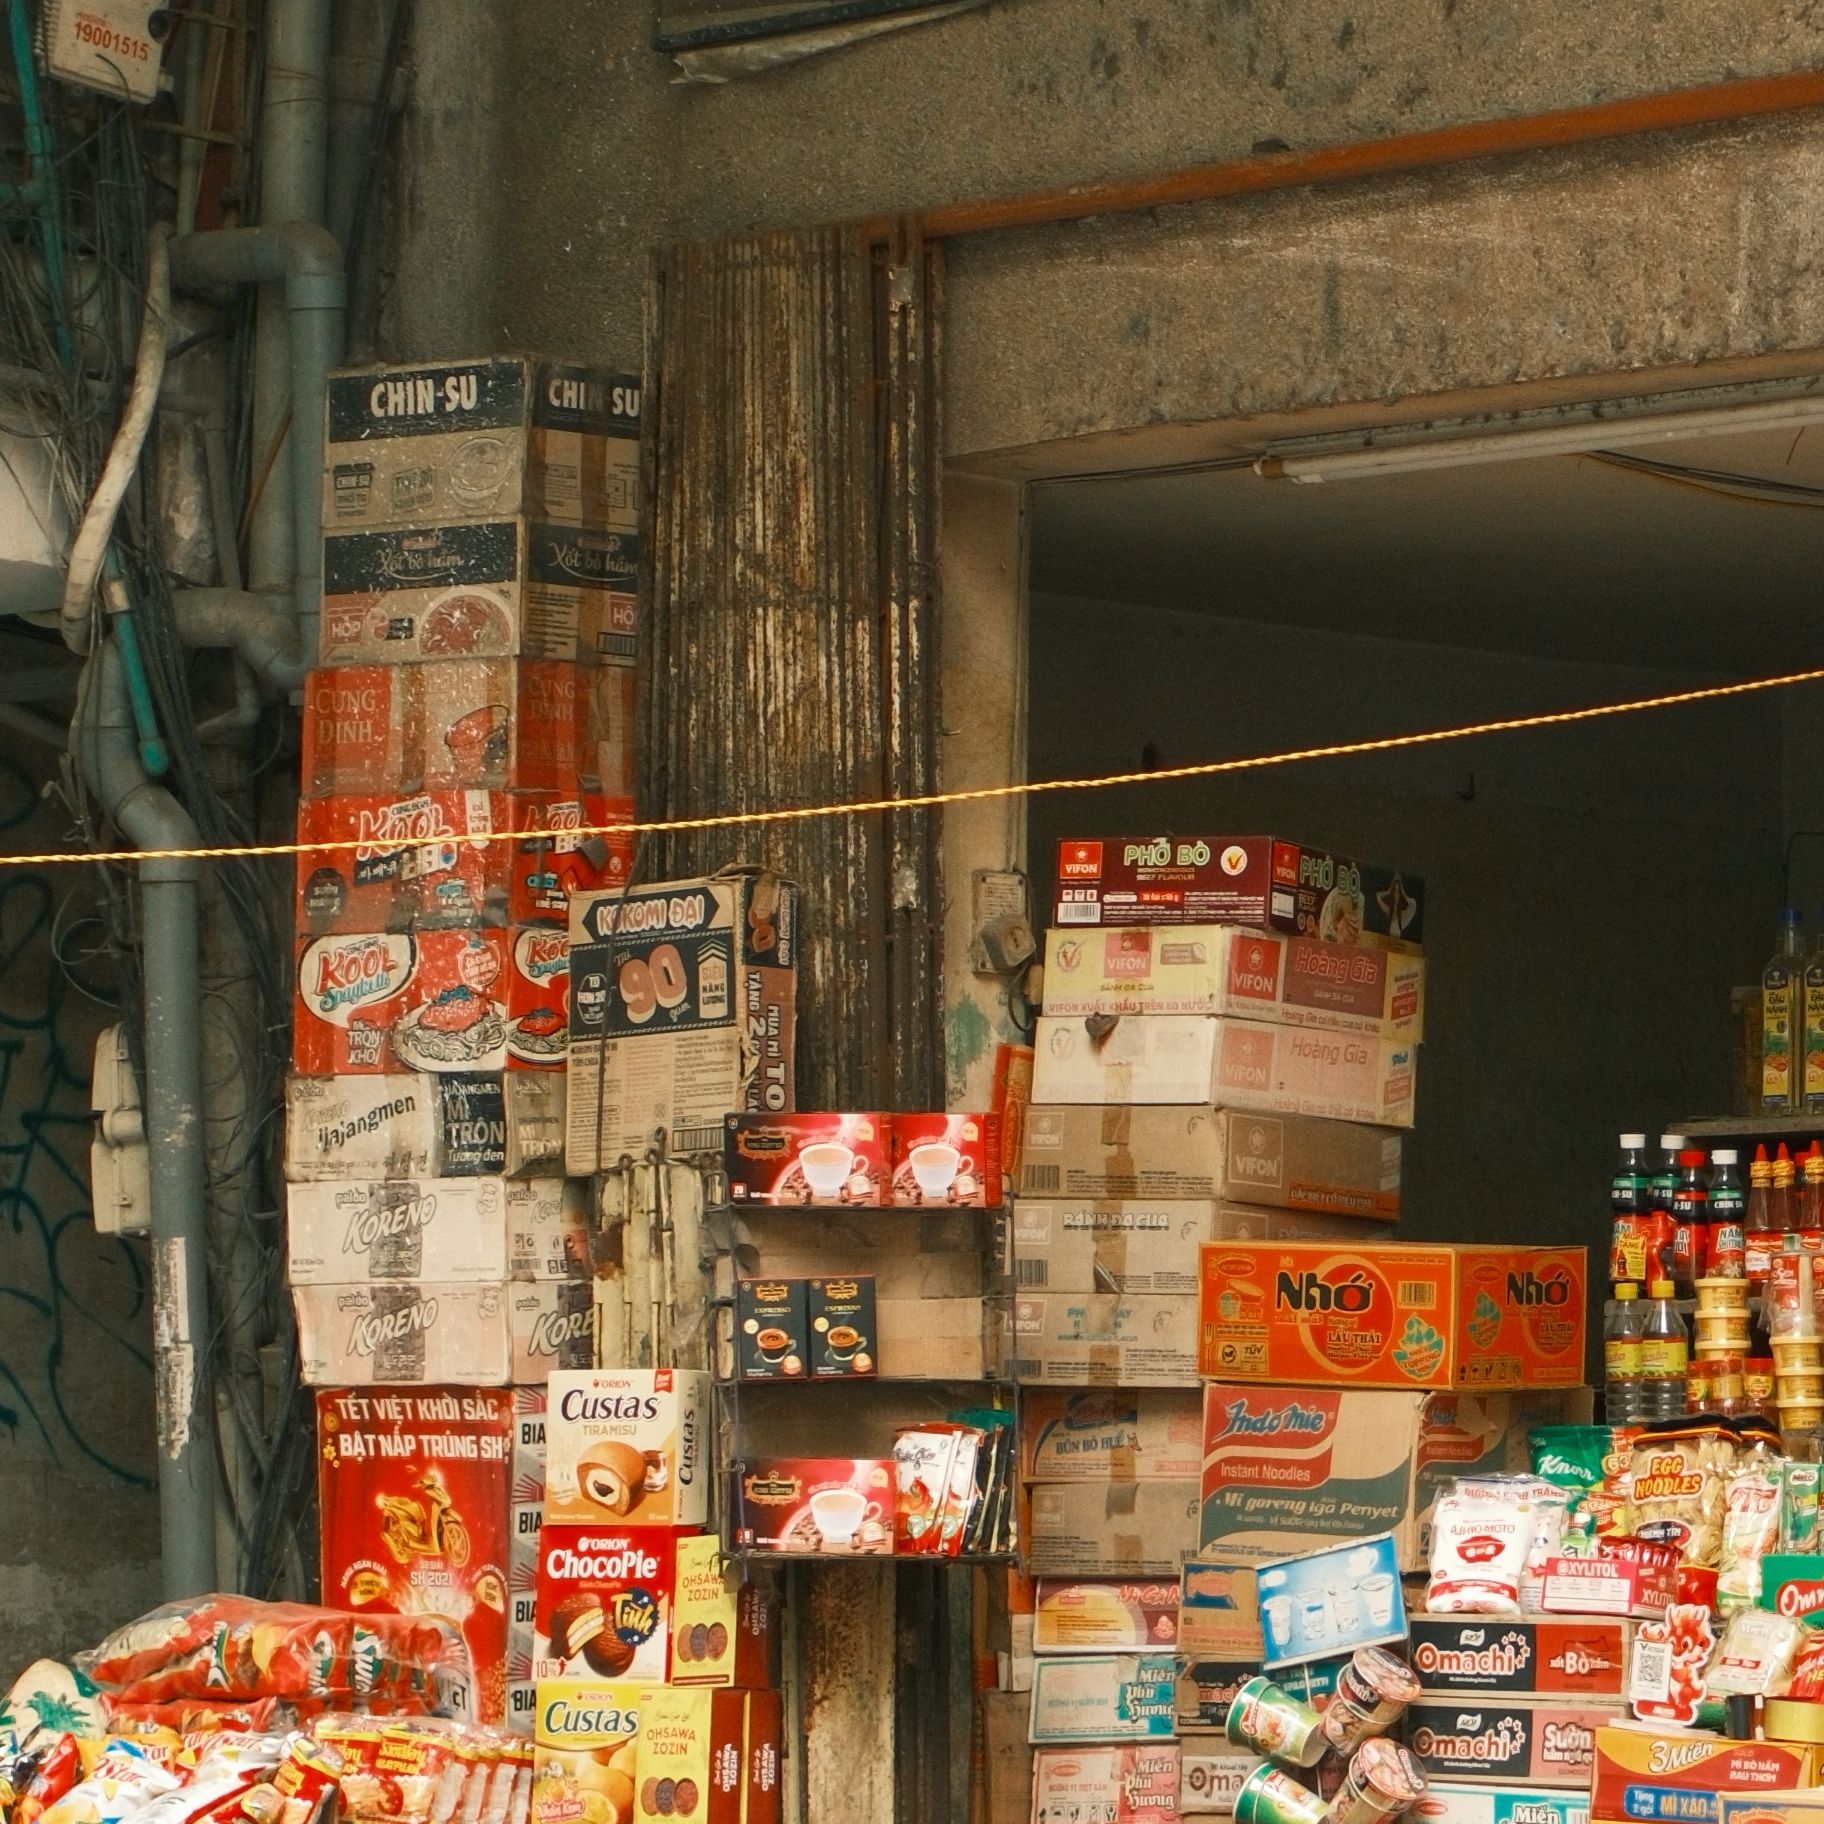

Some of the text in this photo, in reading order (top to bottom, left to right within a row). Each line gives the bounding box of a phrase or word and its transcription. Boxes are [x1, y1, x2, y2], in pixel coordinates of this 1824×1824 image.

[75, 21, 149, 62] 19001515
[370, 375, 477, 417] CHIN-SU
[315, 687, 376, 714] CUNG
[1124, 837, 1210, 866] PHỞ BÒ
[1065, 863, 1098, 874] VIFON
[670, 894, 704, 928] ĐẠI
[620, 943, 687, 1023] 90
[1234, 975, 1274, 994] VIFON
[342, 1194, 437, 1254] KORENO
[1276, 1271, 1374, 1313] Nhớ
[346, 1298, 439, 1356] KORENO
[336, 1389, 498, 1426] TẾT VIỆT SẮC
[561, 1389, 658, 1422] Custas
[340, 1430, 375, 1462] BẬT
[582, 1425, 638, 1436] TIRAMISU
[1220, 1462, 1310, 1482] Instant Noodles
[1651, 1457, 1683, 1474] EGG
[1636, 1477, 1702, 1496] NOODLES
[1340, 1502, 1398, 1519] Penyet
[547, 1545, 657, 1579] ChocoPie
[1416, 1642, 1515, 1674] Omachi
[545, 1701, 638, 1734] Custas
[647, 1727, 696, 1741] OHSAWA
[652, 1742, 688, 1755] ZOZIN
